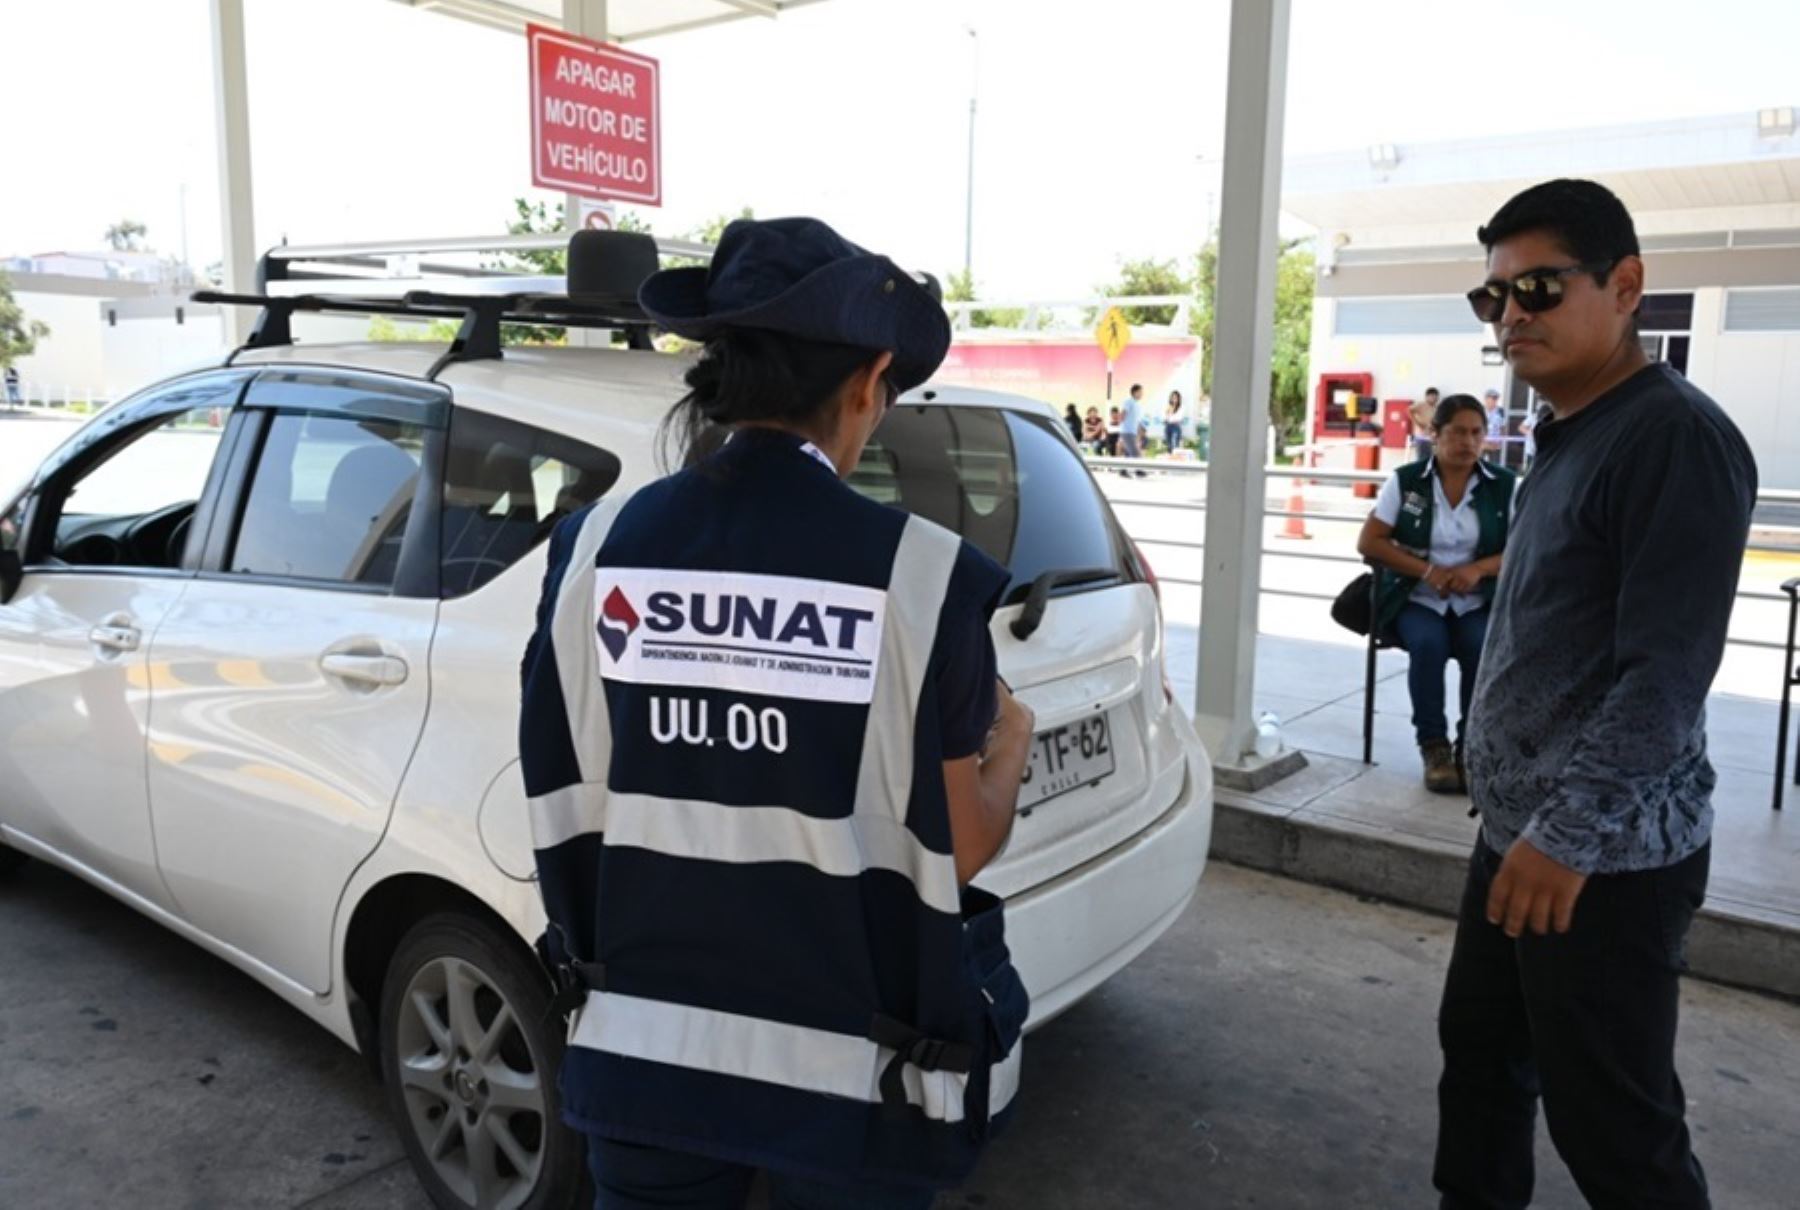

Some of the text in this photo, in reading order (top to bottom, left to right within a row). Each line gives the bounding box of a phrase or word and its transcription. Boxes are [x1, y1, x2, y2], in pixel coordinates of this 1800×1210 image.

[556, 55, 636, 98] APAGAR
[545, 97, 647, 142] MOTOR DE
[547, 140, 646, 183] VEHÍCULO
[644, 591, 874, 650] SUNAT
